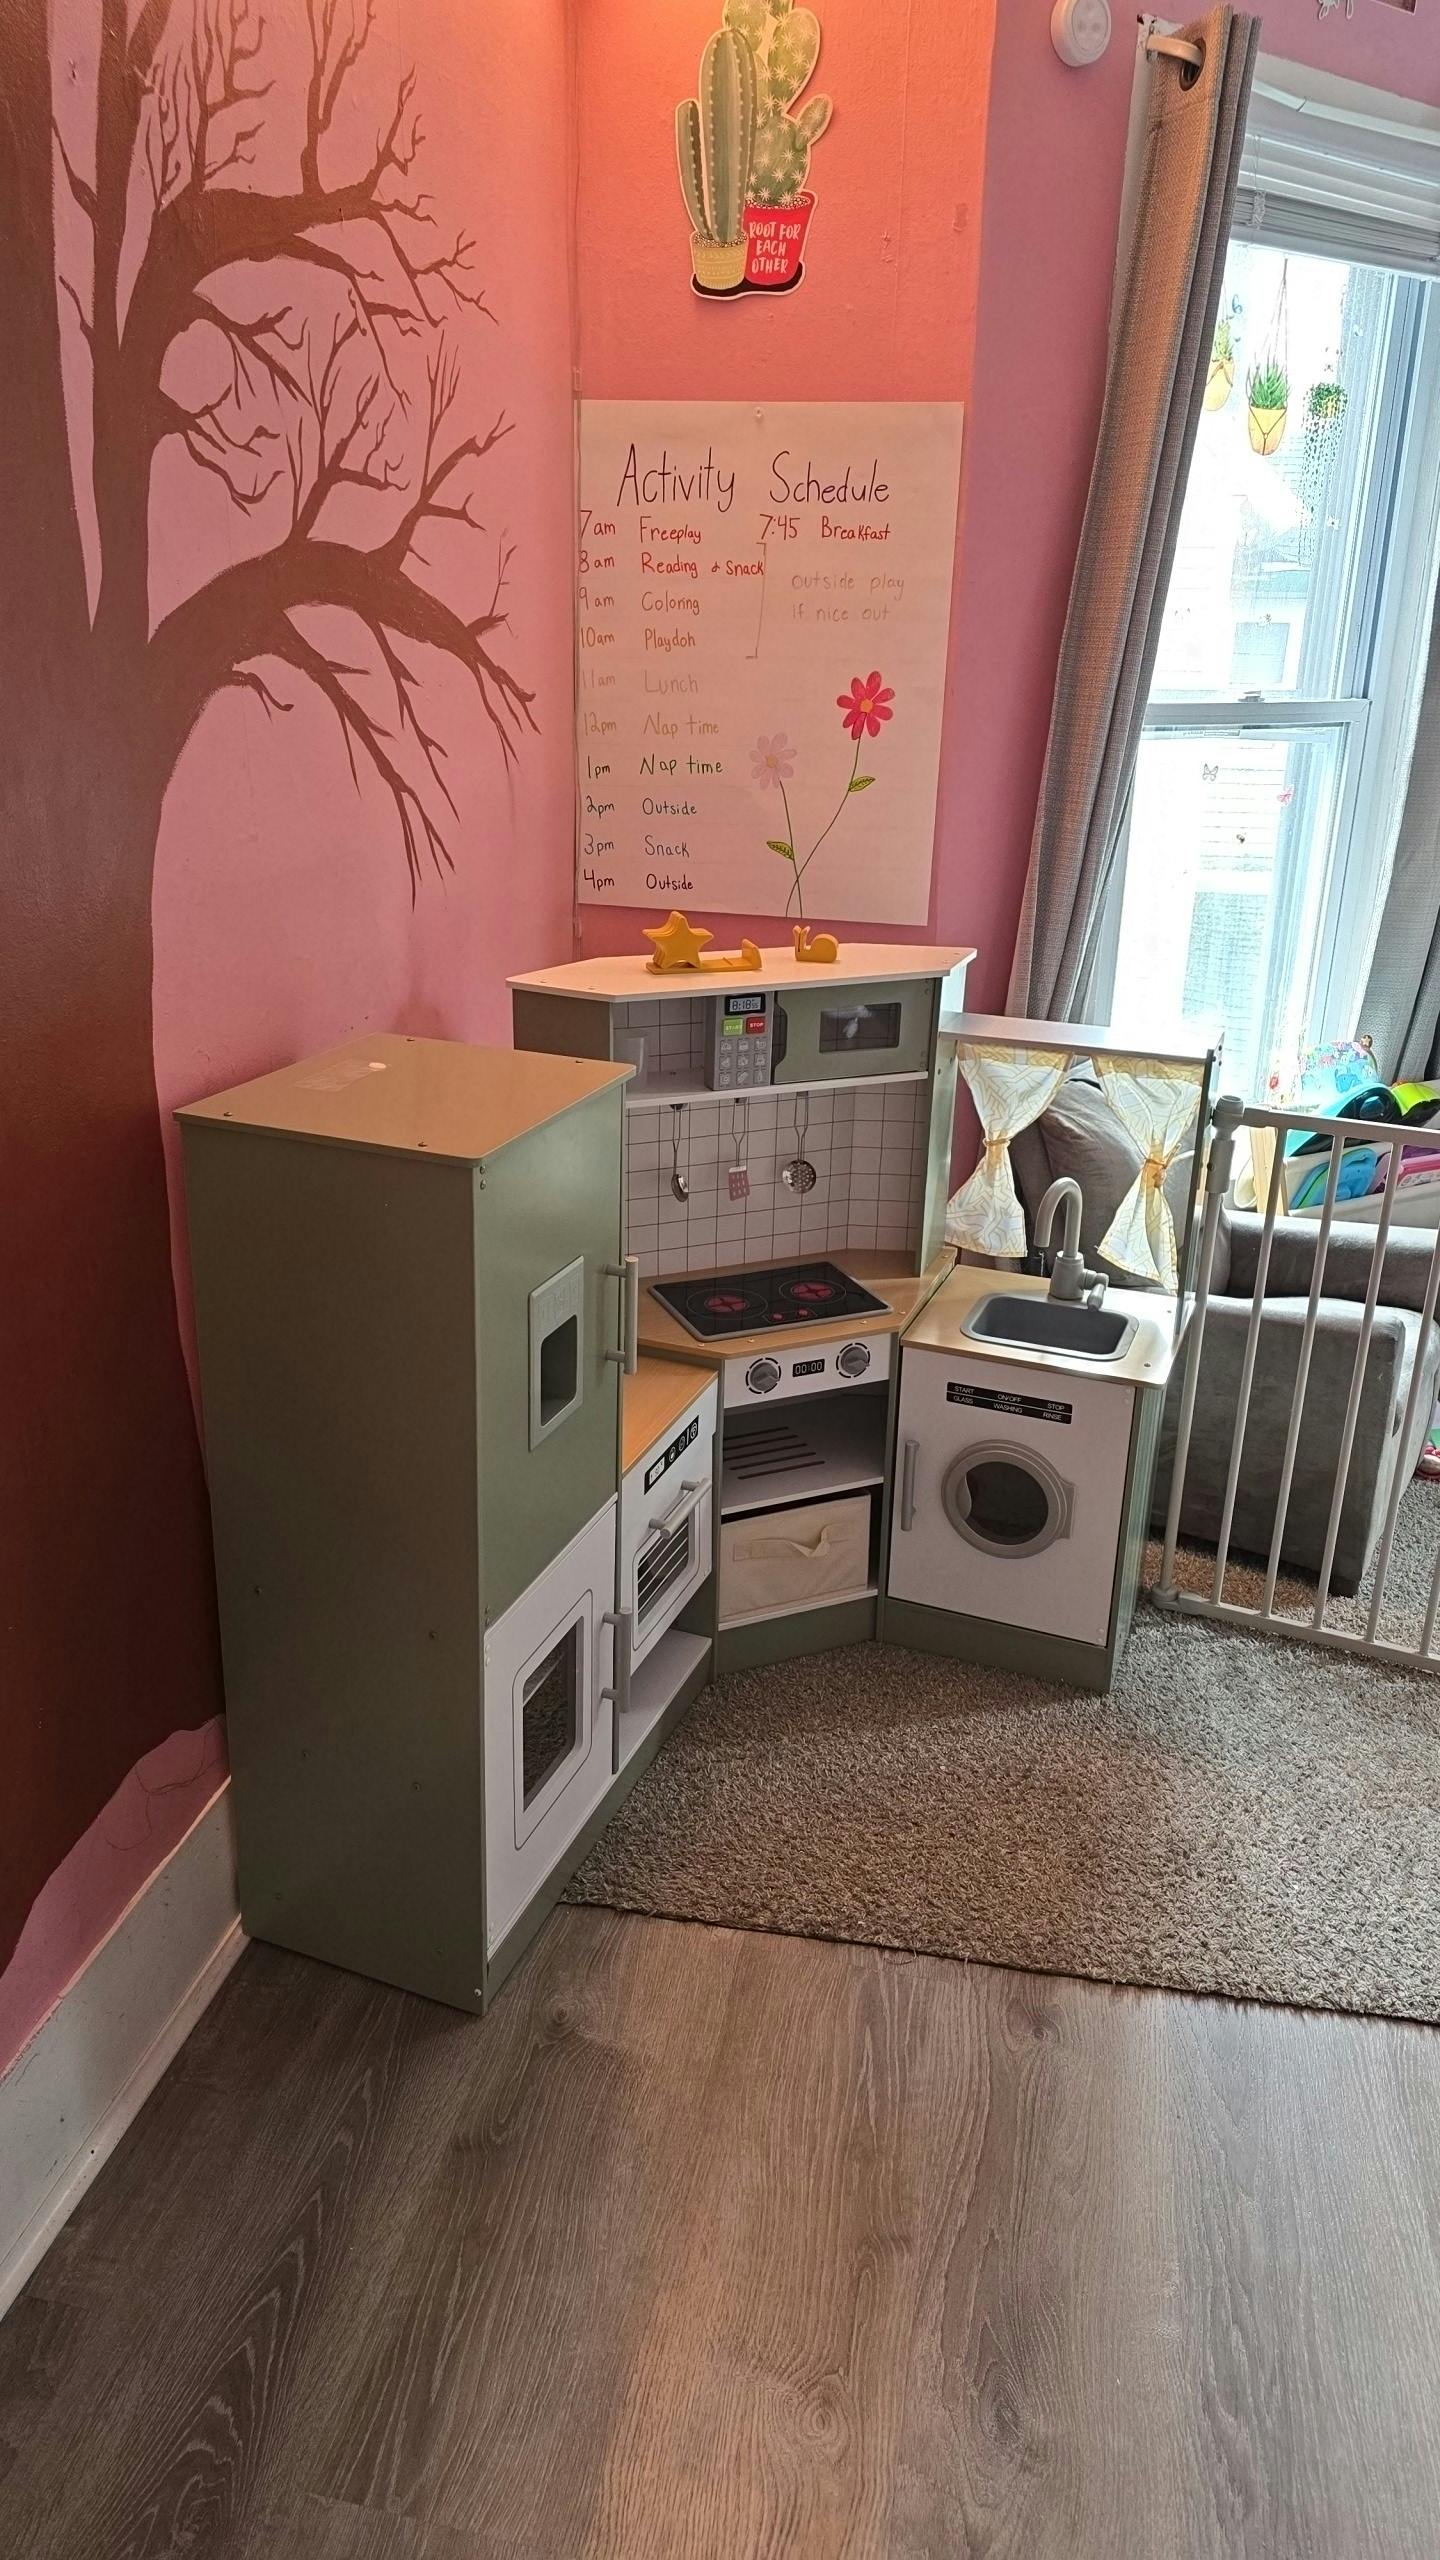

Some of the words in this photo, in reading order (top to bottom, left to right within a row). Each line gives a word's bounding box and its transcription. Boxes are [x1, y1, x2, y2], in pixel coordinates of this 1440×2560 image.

[749, 221, 776, 239] ROOT
[779, 223, 801, 241] FOR
[756, 239, 787, 256] EACH
[751, 257, 789, 274] OTHER
[616, 442, 736, 513] Activity
[769, 450, 890, 504] Schedule
[640, 515, 701, 544] Freeplay
[759, 513, 801, 540] 7:45
[821, 515, 891, 541] Breakfast
[641, 552, 698, 579] Reading
[870, 573, 905, 601] play
[641, 590, 700, 616] Coloring
[816, 607, 849, 622] nice
[862, 604, 892, 621] out
[580, 626, 616, 648] 10am
[645, 628, 696, 652] Playdoh
[582, 669, 616, 690] 11am
[644, 669, 699, 694] Lunch
[584, 711, 617, 736] 12pm
[643, 711, 679, 739] Nap
[686, 714, 720, 736] time
[587, 755, 611, 779] 1pm
[640, 753, 677, 776] Nap
[686, 754, 723, 775] time
[586, 795, 615, 820] 2pm
[642, 796, 698, 816] Outside
[584, 833, 615, 857] 3pm
[644, 835, 690, 858] Snack
[583, 869, 615, 892] 4pm
[645, 873, 694, 892] Outside
[954, 1385, 975, 1395] START
[997, 1393, 1022, 1403] ON/OFF
[1047, 1402, 1065, 1411] STOP
[993, 1402, 1023, 1414] WASHING
[1042, 1411, 1062, 1421] RINSE
